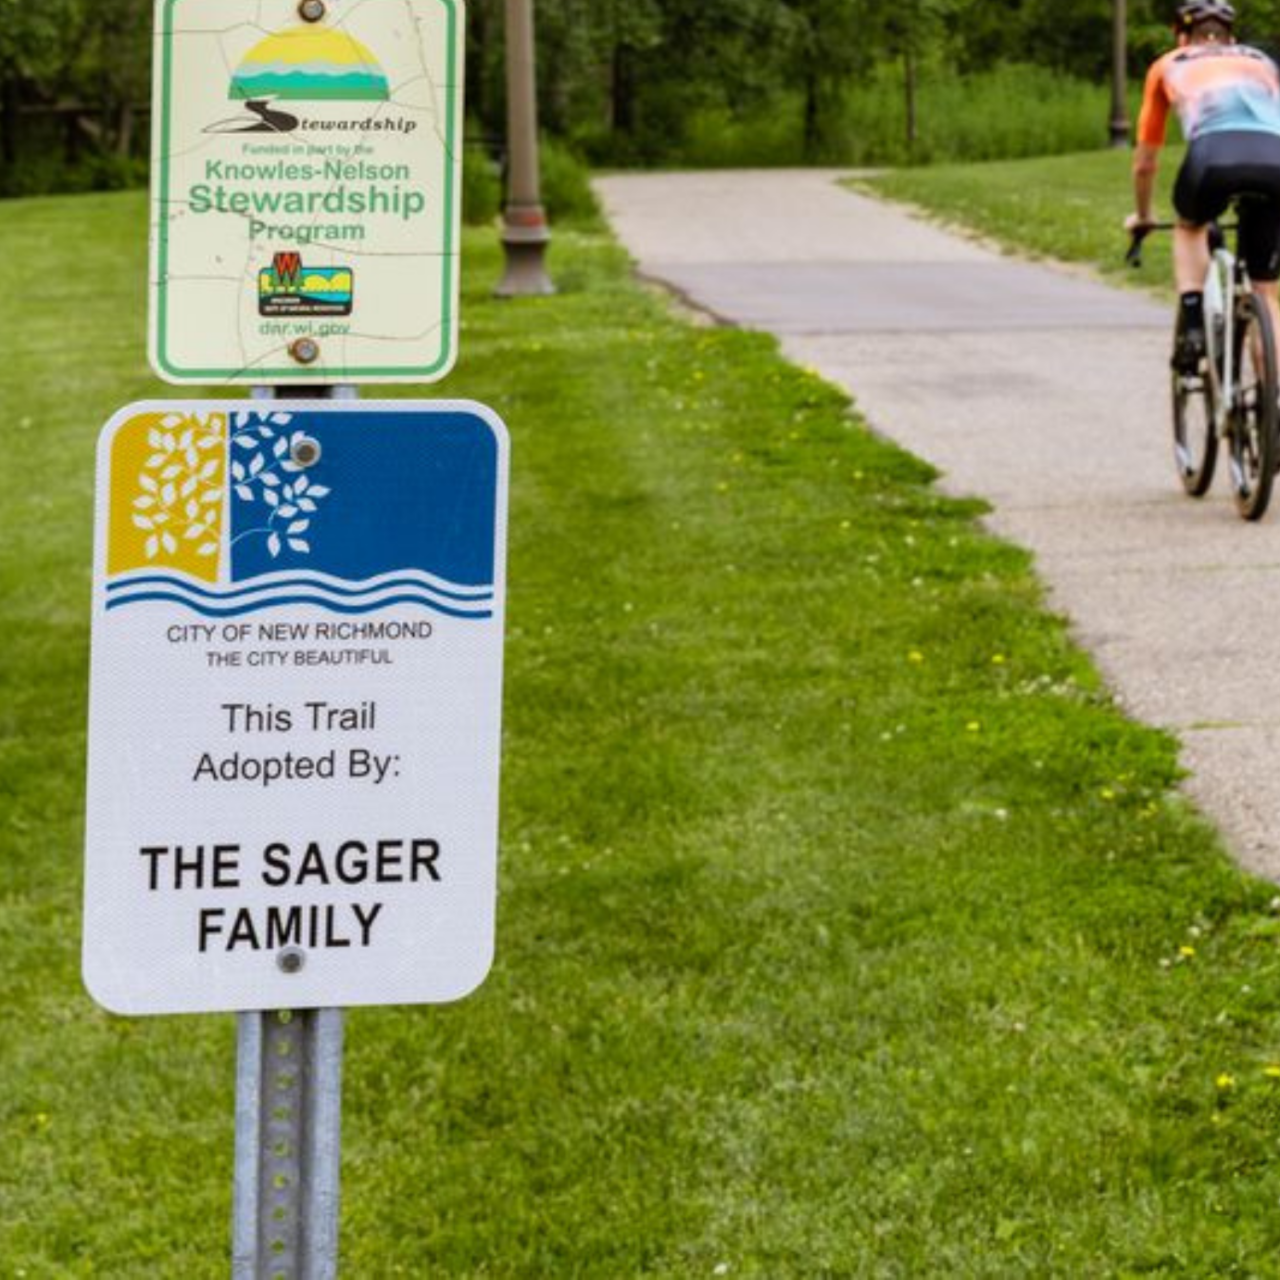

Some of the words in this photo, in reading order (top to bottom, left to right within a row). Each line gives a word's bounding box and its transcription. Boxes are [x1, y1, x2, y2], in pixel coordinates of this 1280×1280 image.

[205, 159, 410, 181] Knowles-Nelson
[189, 185, 425, 220] Stewardship
[249, 221, 366, 245] Program
[167, 624, 216, 643] CITY
[222, 624, 252, 642] OF
[258, 623, 310, 641] NEW
[315, 622, 433, 640] RICHMOND
[206, 652, 242, 667] THE
[247, 651, 289, 667] CITY
[294, 649, 393, 666] BEAUTIFUL
[221, 703, 293, 733] This
[304, 701, 376, 732] Trail
[193, 750, 336, 786] Adopted
[349, 749, 401, 784] By:
[140, 845, 241, 891] THE
[261, 838, 442, 888] SAGER
[199, 902, 383, 953] FAMILY
